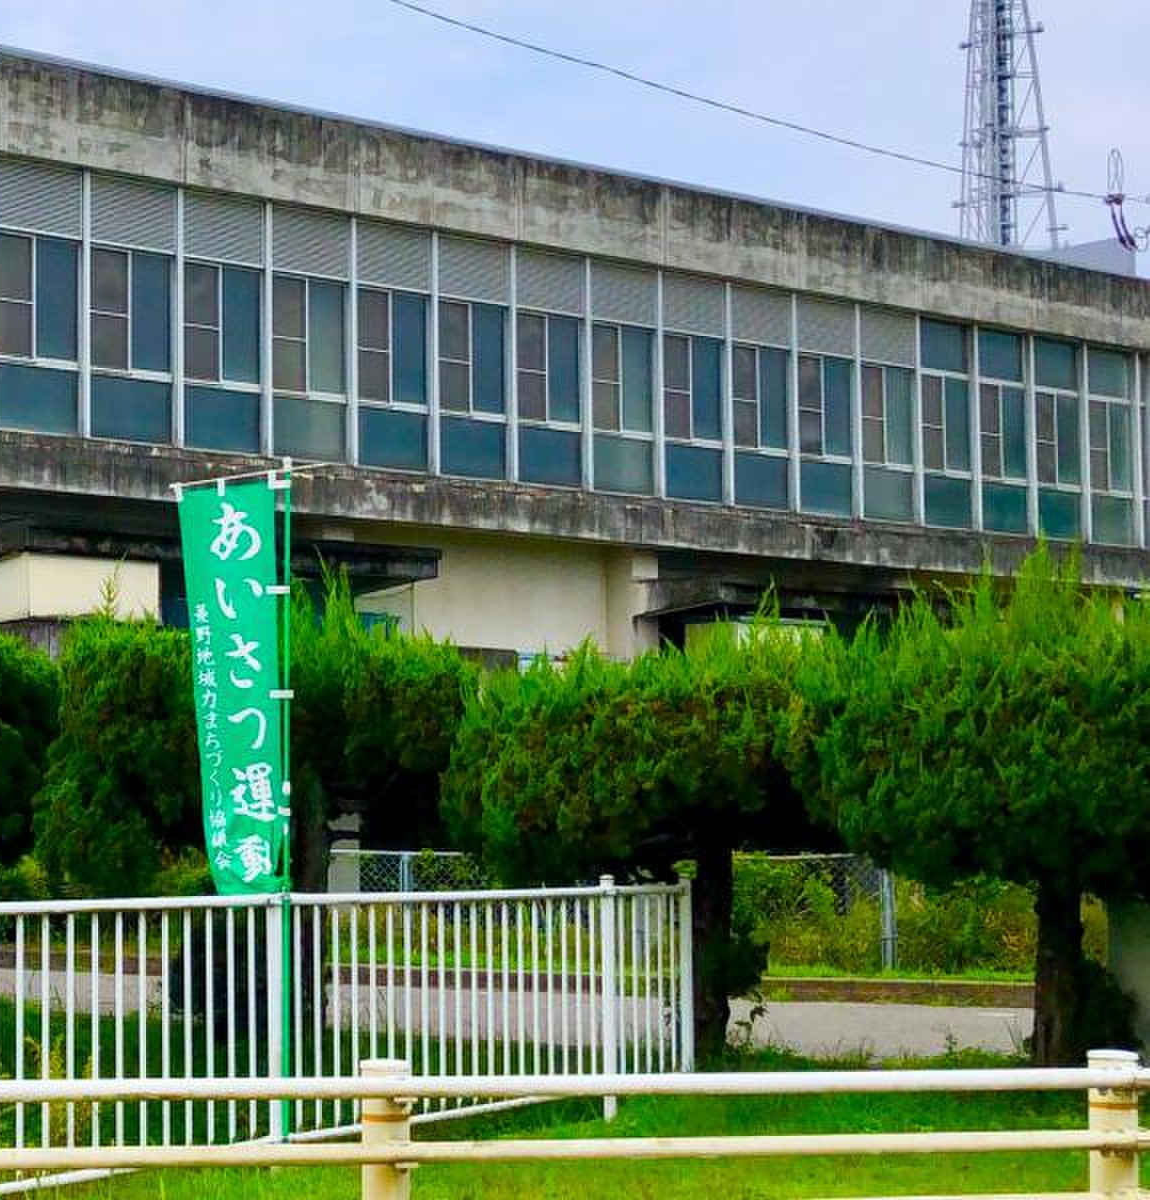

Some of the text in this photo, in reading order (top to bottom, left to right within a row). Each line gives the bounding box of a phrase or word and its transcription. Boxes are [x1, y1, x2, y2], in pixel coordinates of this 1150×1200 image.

[210, 503, 277, 883] あいさつ運動
